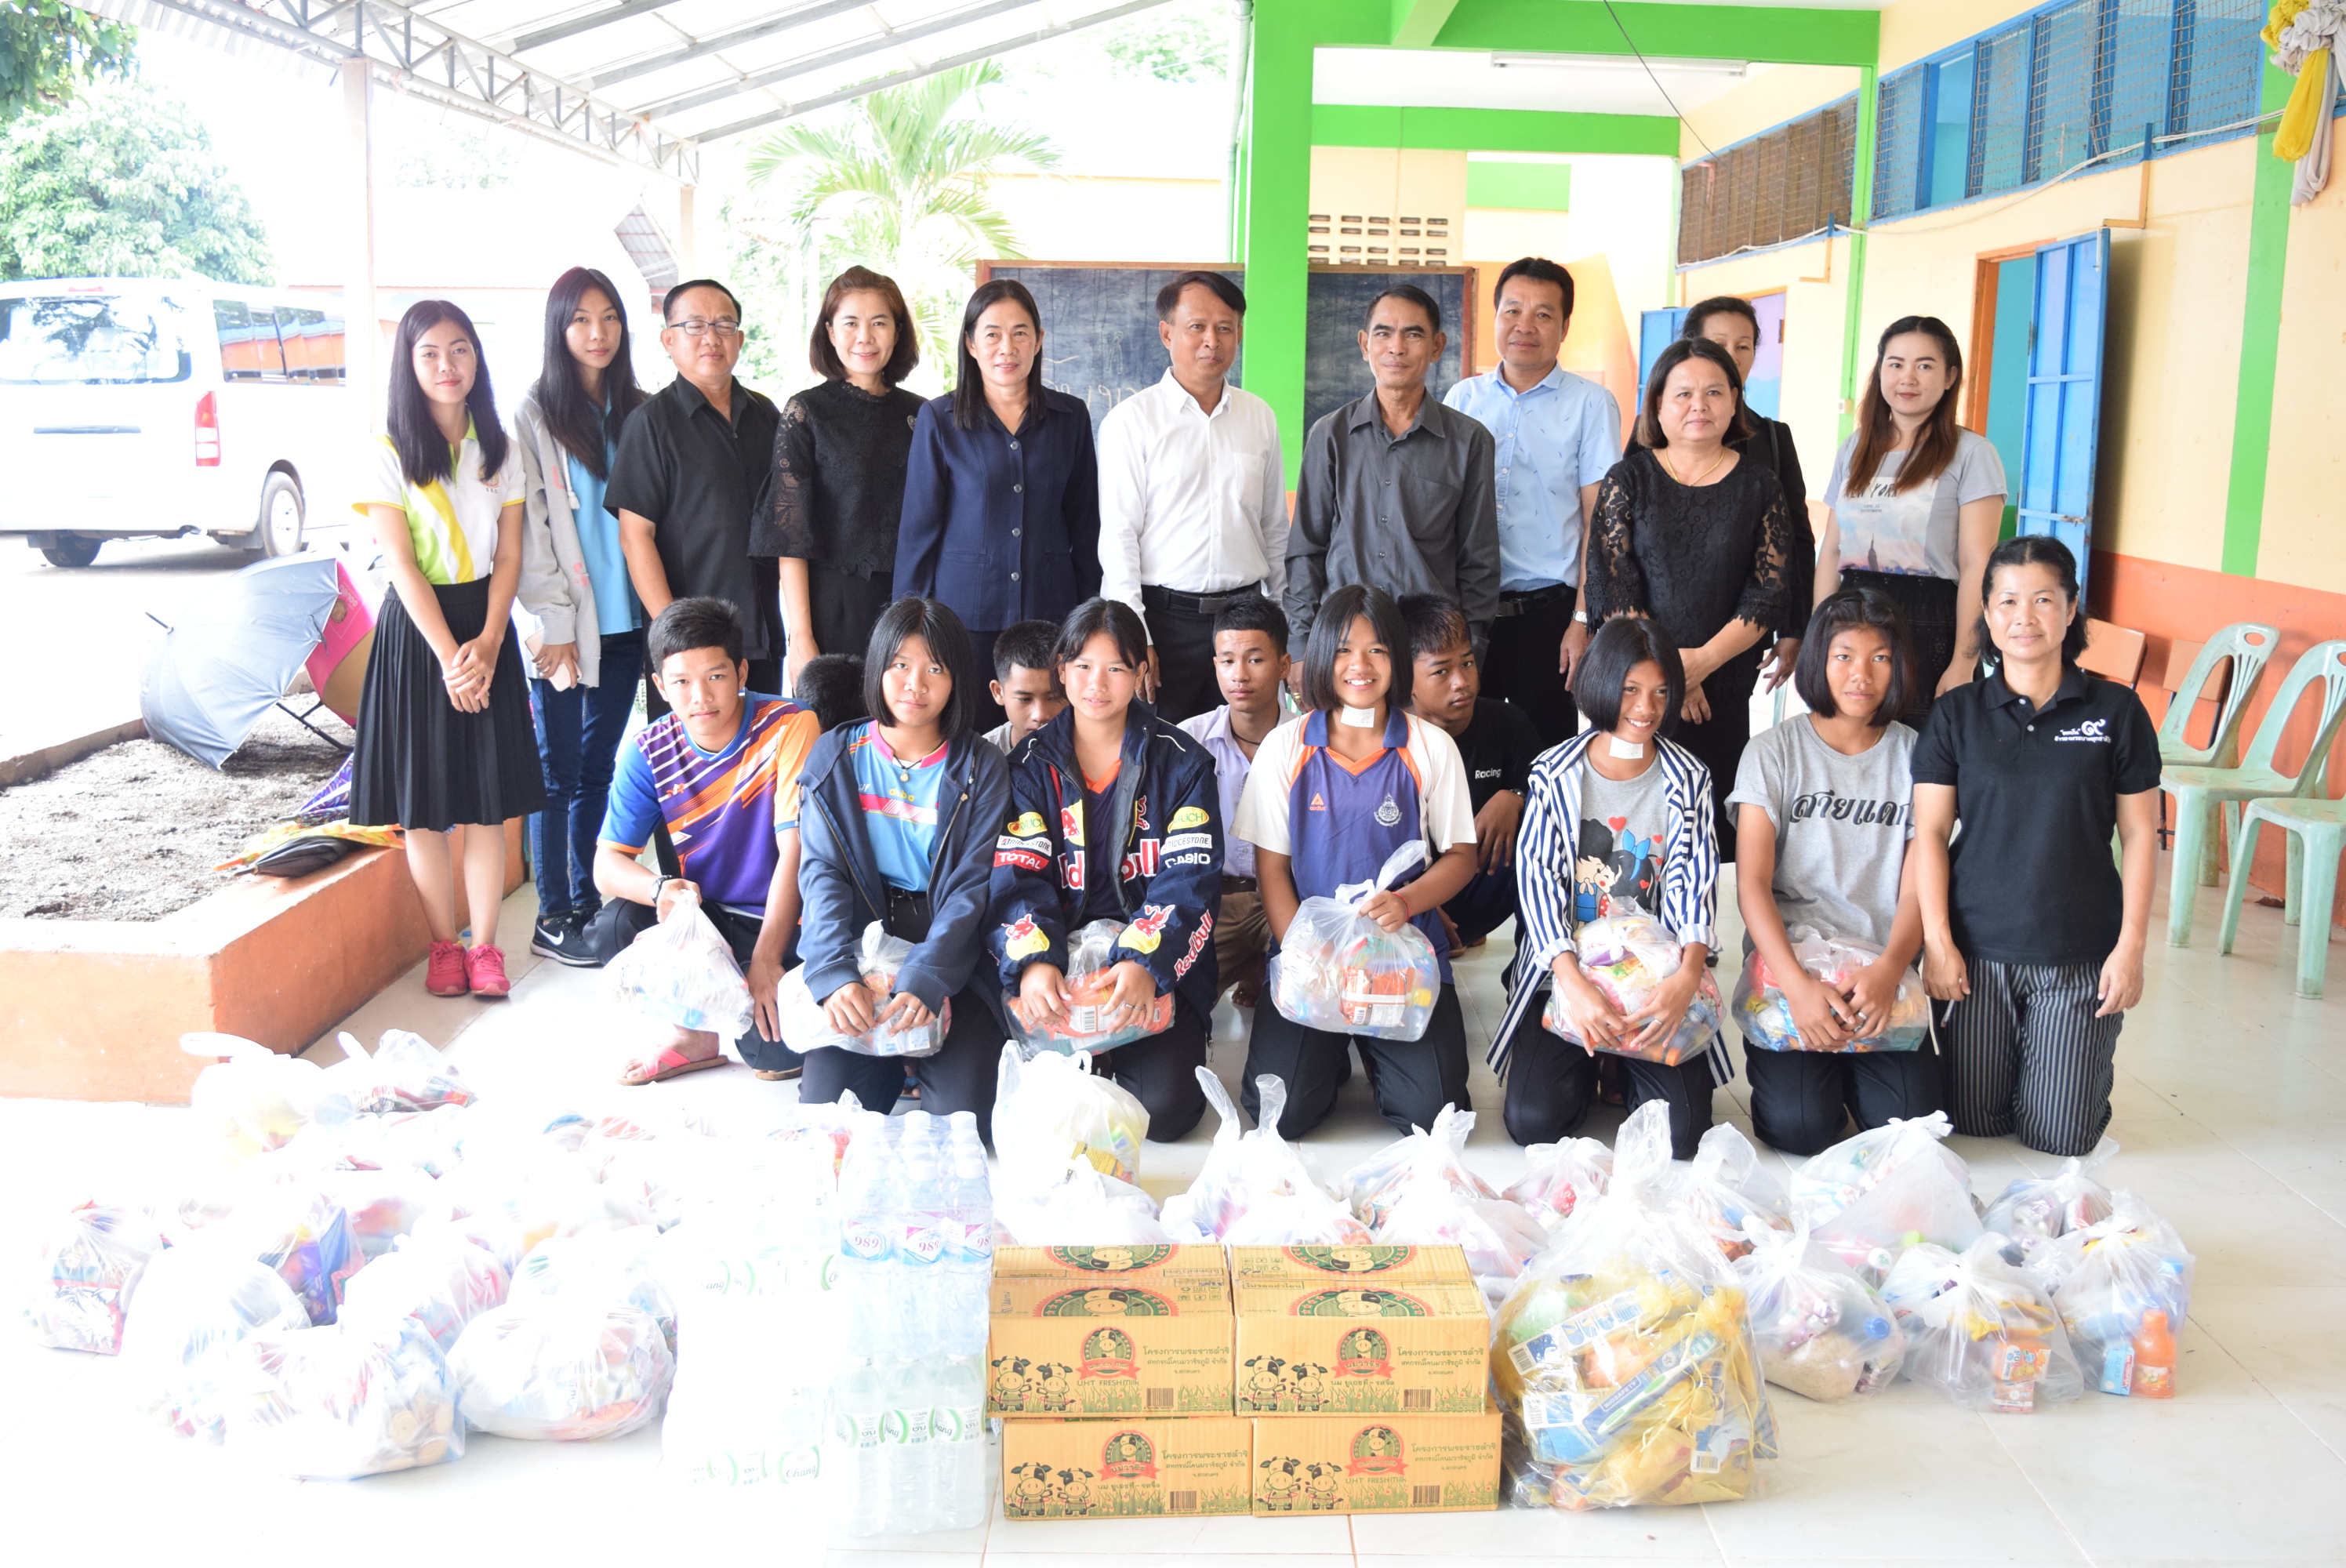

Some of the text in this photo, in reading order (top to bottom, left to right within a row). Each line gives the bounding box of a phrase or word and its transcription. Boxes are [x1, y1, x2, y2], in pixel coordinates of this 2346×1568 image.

[1475, 768, 1502, 779] Racing
[1000, 838, 1051, 852] BRIDGESTONE
[997, 851, 1041, 870] TOTAL
[1164, 852, 1211, 869] CASIO
[854, 1235, 880, 1248] 989
[1143, 1345, 1230, 1356] โครงการพระราชดำริ
[1397, 1346, 1484, 1356] โครงการพระราชดำริ
[1603, 1379, 1638, 1409] BIOSAFETY
[1411, 1442, 1497, 1454] โครงการพระราชดำริ
[1161, 1449, 1248, 1460] โครงการพระราชดำริ
